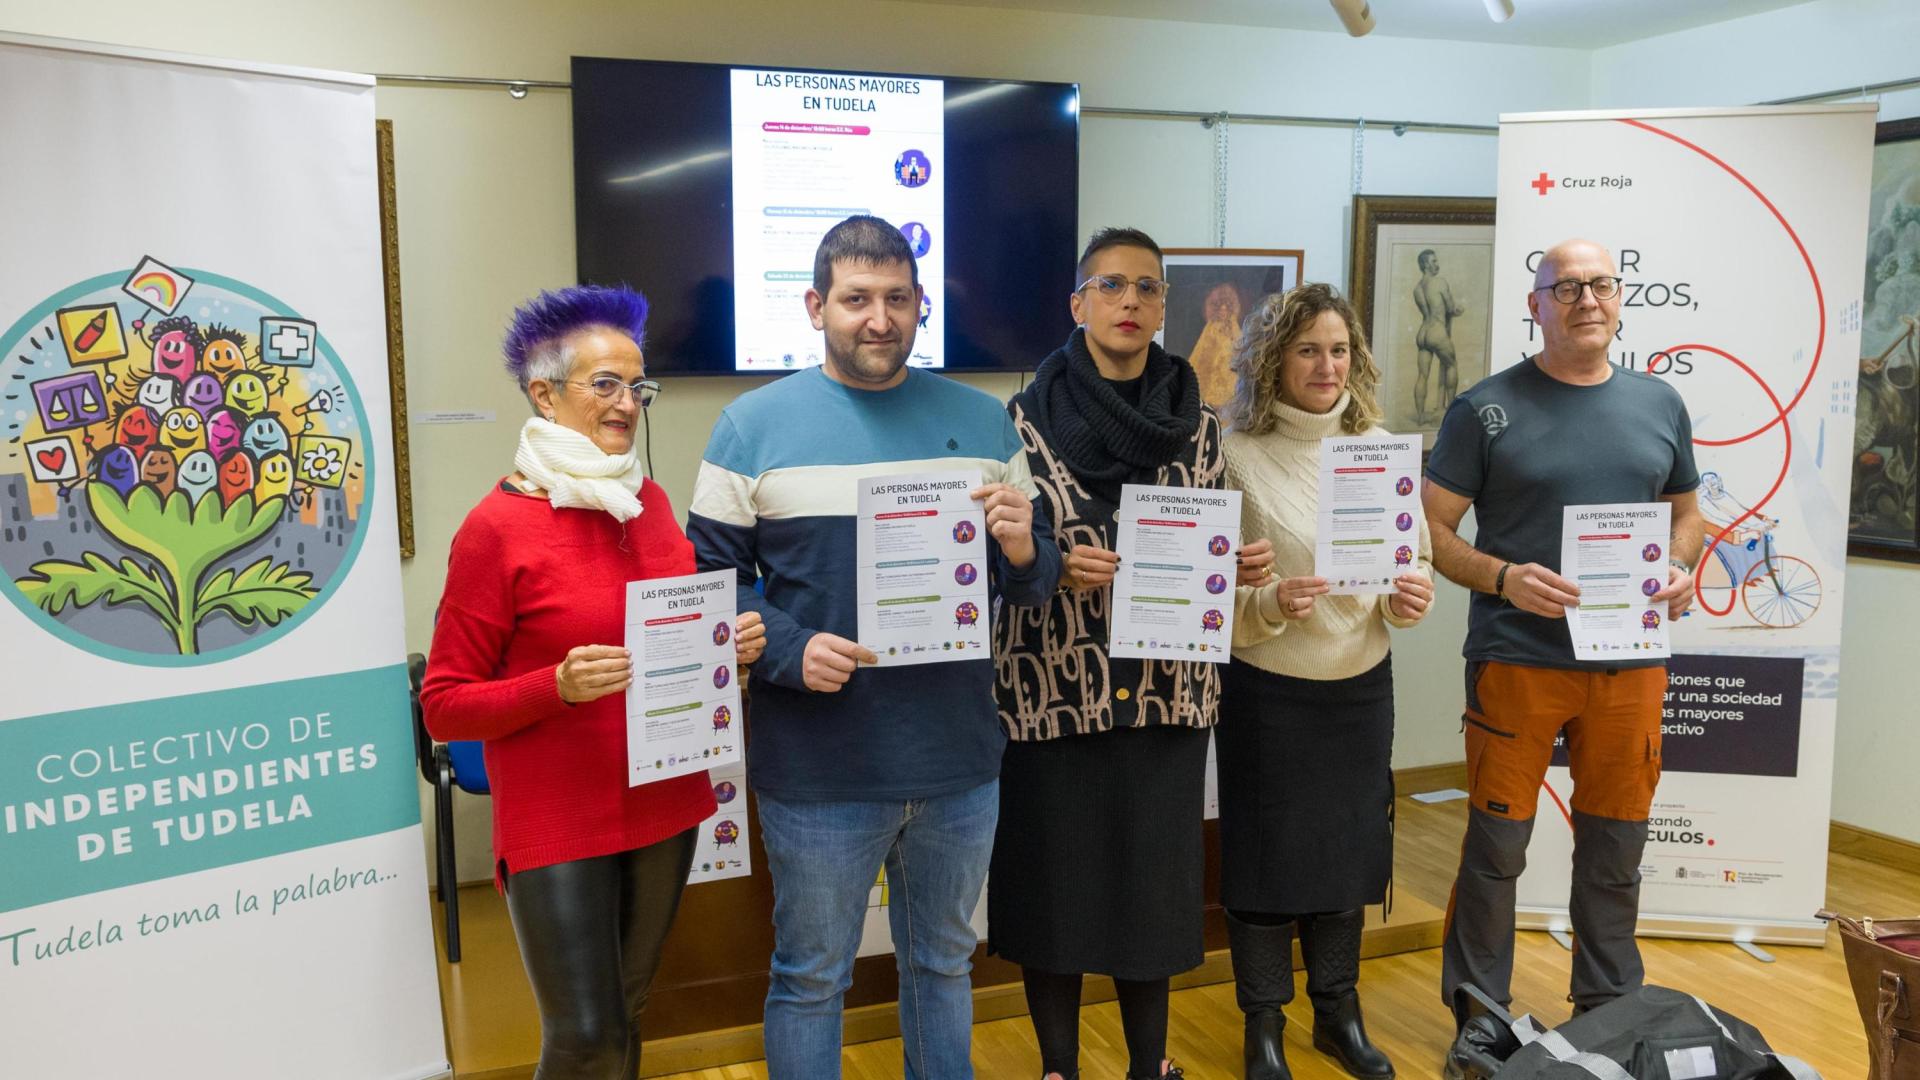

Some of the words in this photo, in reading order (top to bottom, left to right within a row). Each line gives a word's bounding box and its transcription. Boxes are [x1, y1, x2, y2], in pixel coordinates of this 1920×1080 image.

[756, 74, 781, 88] LAS
[785, 75, 855, 90] PERSONAS
[860, 79, 920, 94] MAYORES
[804, 96, 820, 109] EN
[825, 97, 876, 112] TUDELA
[1562, 177, 1596, 188] Cruz
[1601, 176, 1632, 189] Roja
[1623, 282, 1698, 312] ZOS,
[872, 486, 885, 495] LAS
[888, 483, 928, 493] PERSONAS
[930, 481, 967, 490] MAYORES
[910, 494, 941, 503] TUDELA
[1152, 495, 1190, 504] PERSONAS
[1192, 497, 1227, 506] MAYORES
[1173, 507, 1200, 515] TUDELA
[642, 590, 656, 599] LAS
[658, 586, 695, 598] PERSONAS
[696, 581, 724, 592] MAYORES
[668, 601, 677, 609] EN
[680, 596, 704, 607] TUDELA
[1715, 678, 1745, 689] que
[1680, 692, 1708, 702] una
[1712, 692, 1782, 706] sociedad
[1679, 708, 1744, 722] mayores
[37, 722, 270, 784] COLECTIVO
[289, 712, 332, 743] DE
[4, 743, 378, 834] INDEPENDIENTES
[77, 826, 133, 862] DE
[153, 794, 313, 847] TUDELA
[1648, 816, 1692, 827] zando
[0, 920, 123, 966] Tudela
[137, 903, 220, 936] toma
[236, 889, 260, 915] la
[273, 866, 398, 915] palabra...
